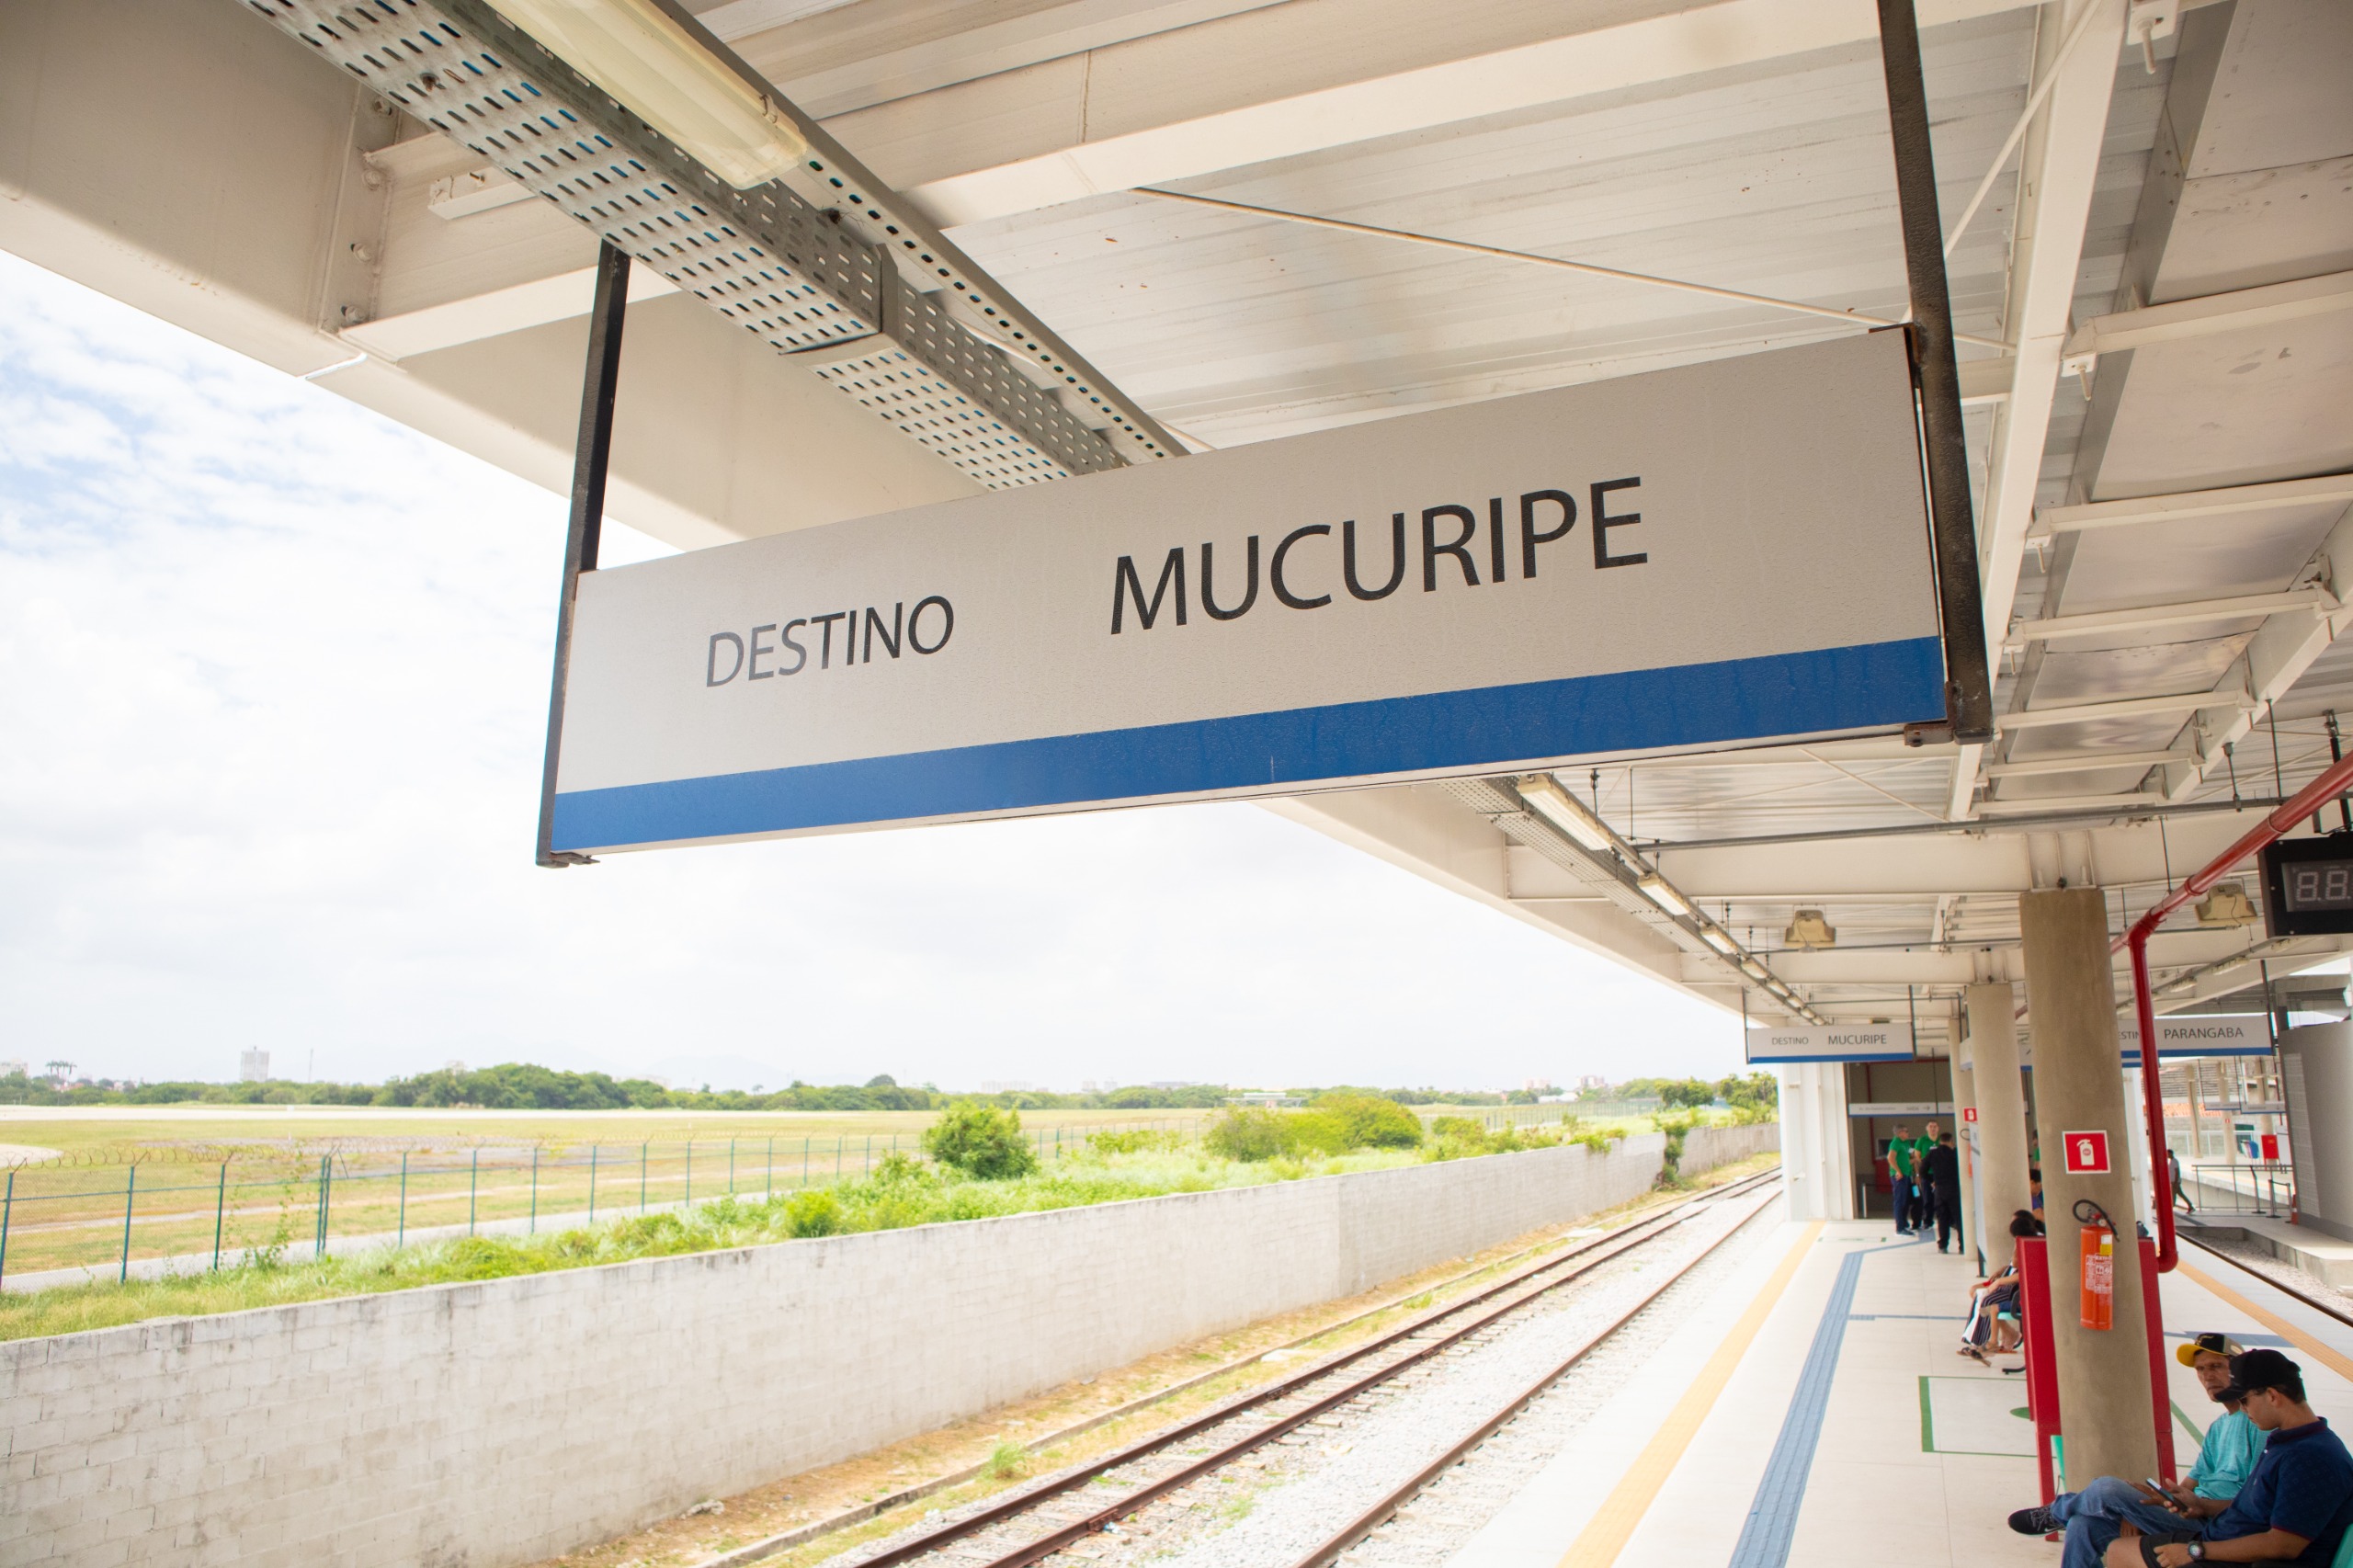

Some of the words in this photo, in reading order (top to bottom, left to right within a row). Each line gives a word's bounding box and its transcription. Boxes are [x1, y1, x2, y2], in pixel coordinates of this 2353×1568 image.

[706, 595, 955, 687] DESTINO
[1110, 476, 1648, 635] MUCURIPE
[1771, 1037, 1809, 1045] DESTINO
[1828, 1034, 1887, 1045] MUCURIPE
[2164, 1027, 2245, 1040] PARANGABA
